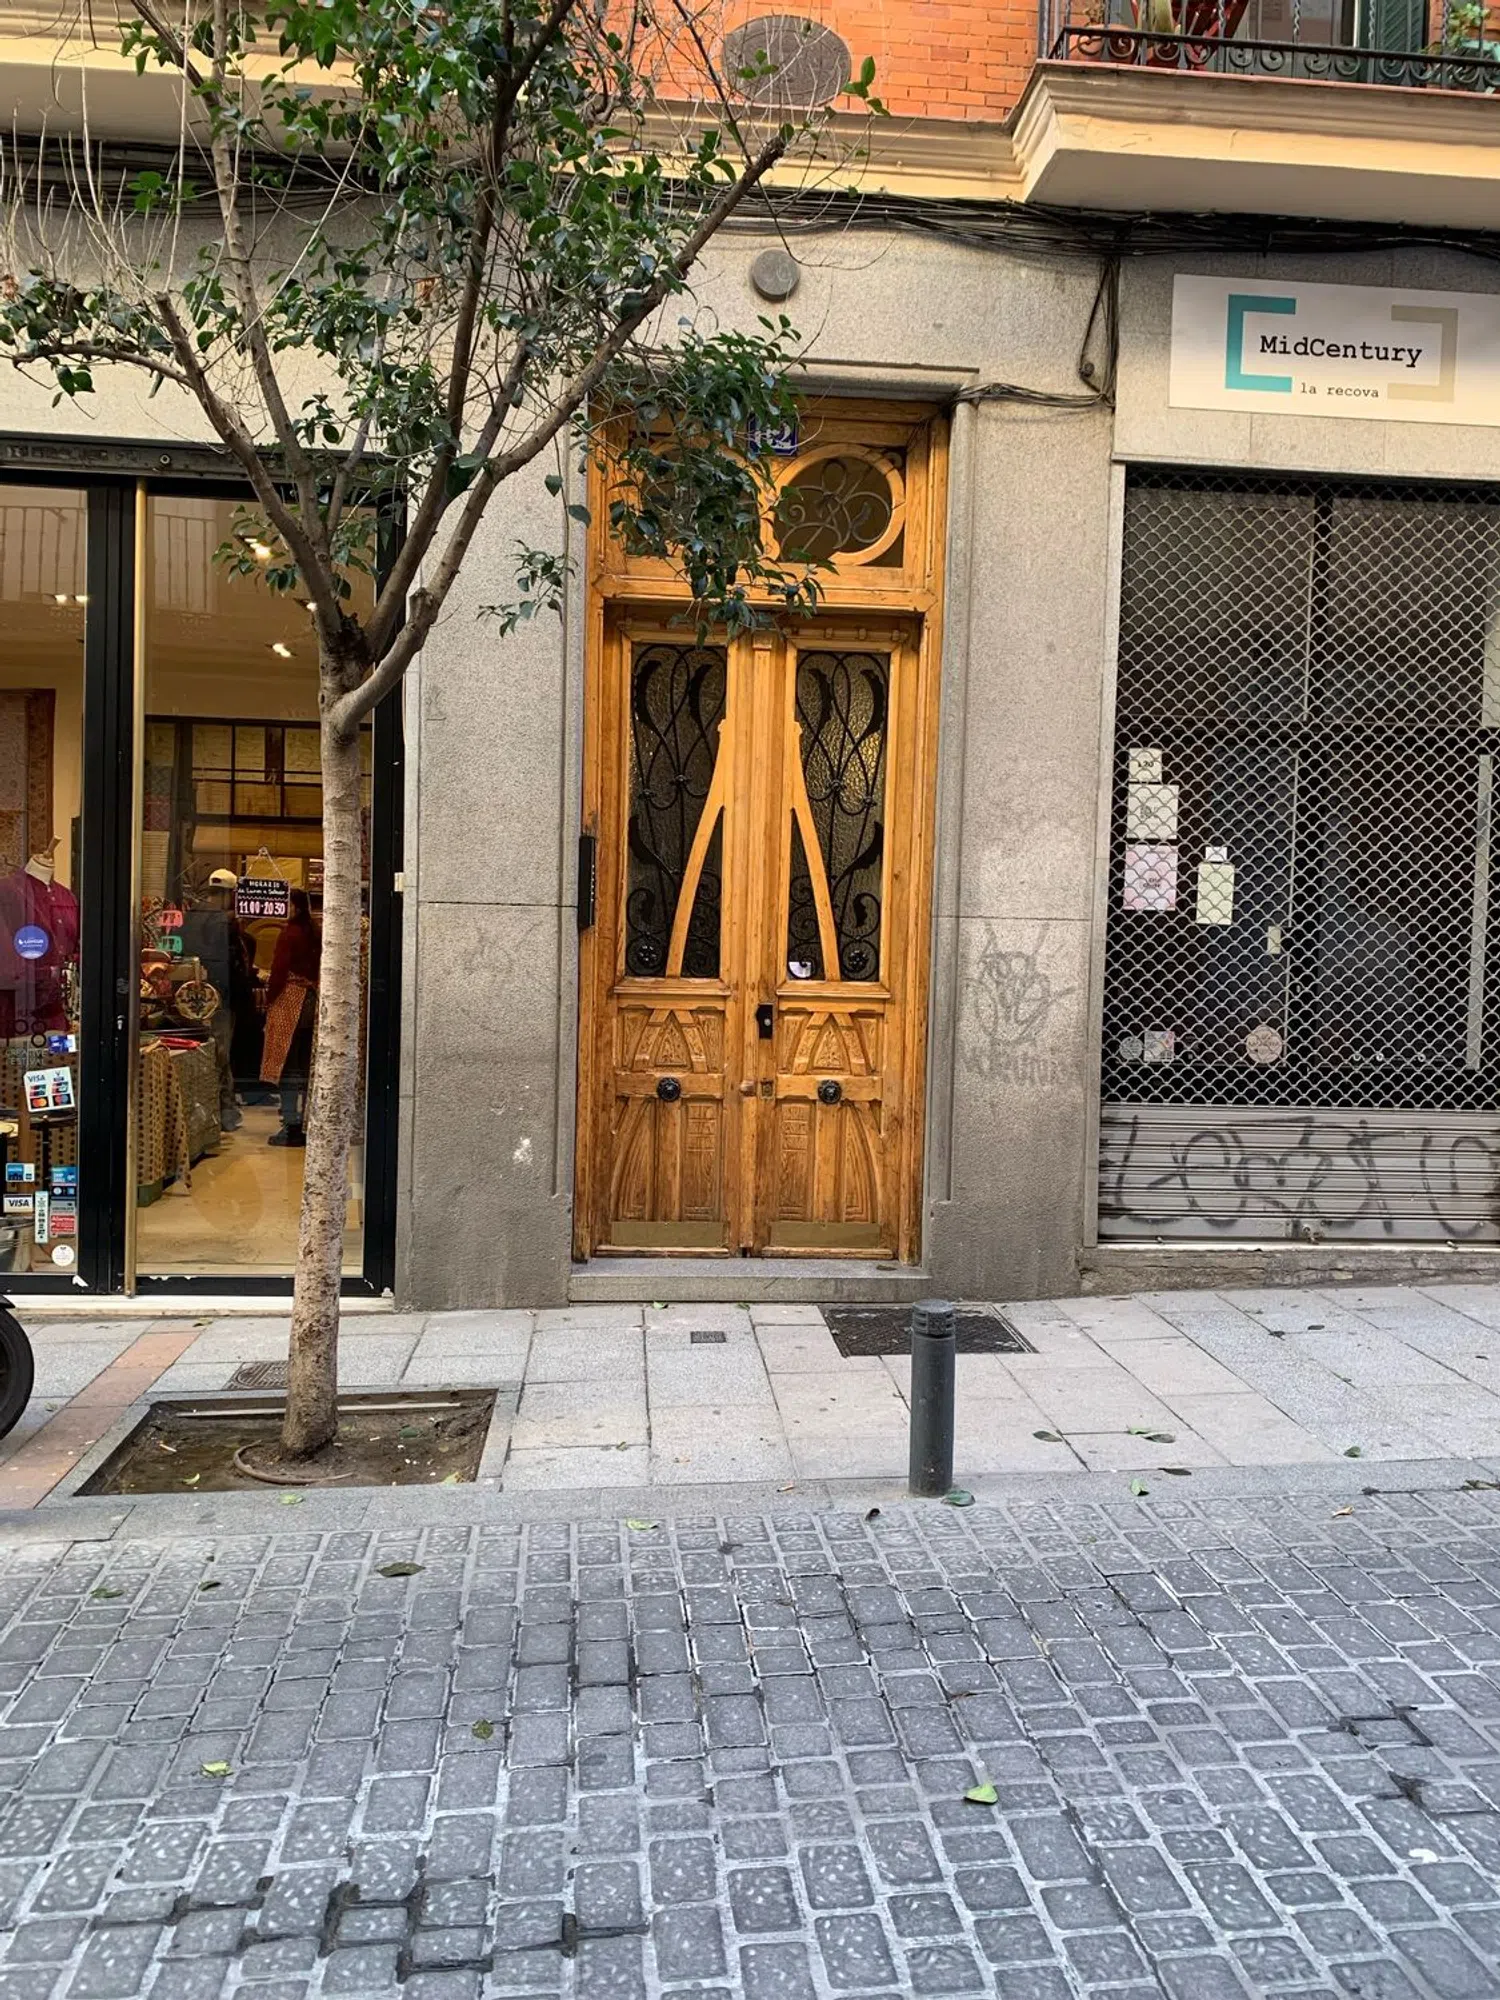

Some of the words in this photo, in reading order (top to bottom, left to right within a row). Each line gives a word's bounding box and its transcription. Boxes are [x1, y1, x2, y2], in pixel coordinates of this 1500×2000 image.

[1260, 335, 1422, 368] MidCentury
[1300, 382, 1317, 395] la
[1327, 386, 1379, 398] recova
[27, 1074, 46, 1083] VISA
[8, 1199, 29, 1207] VISA
